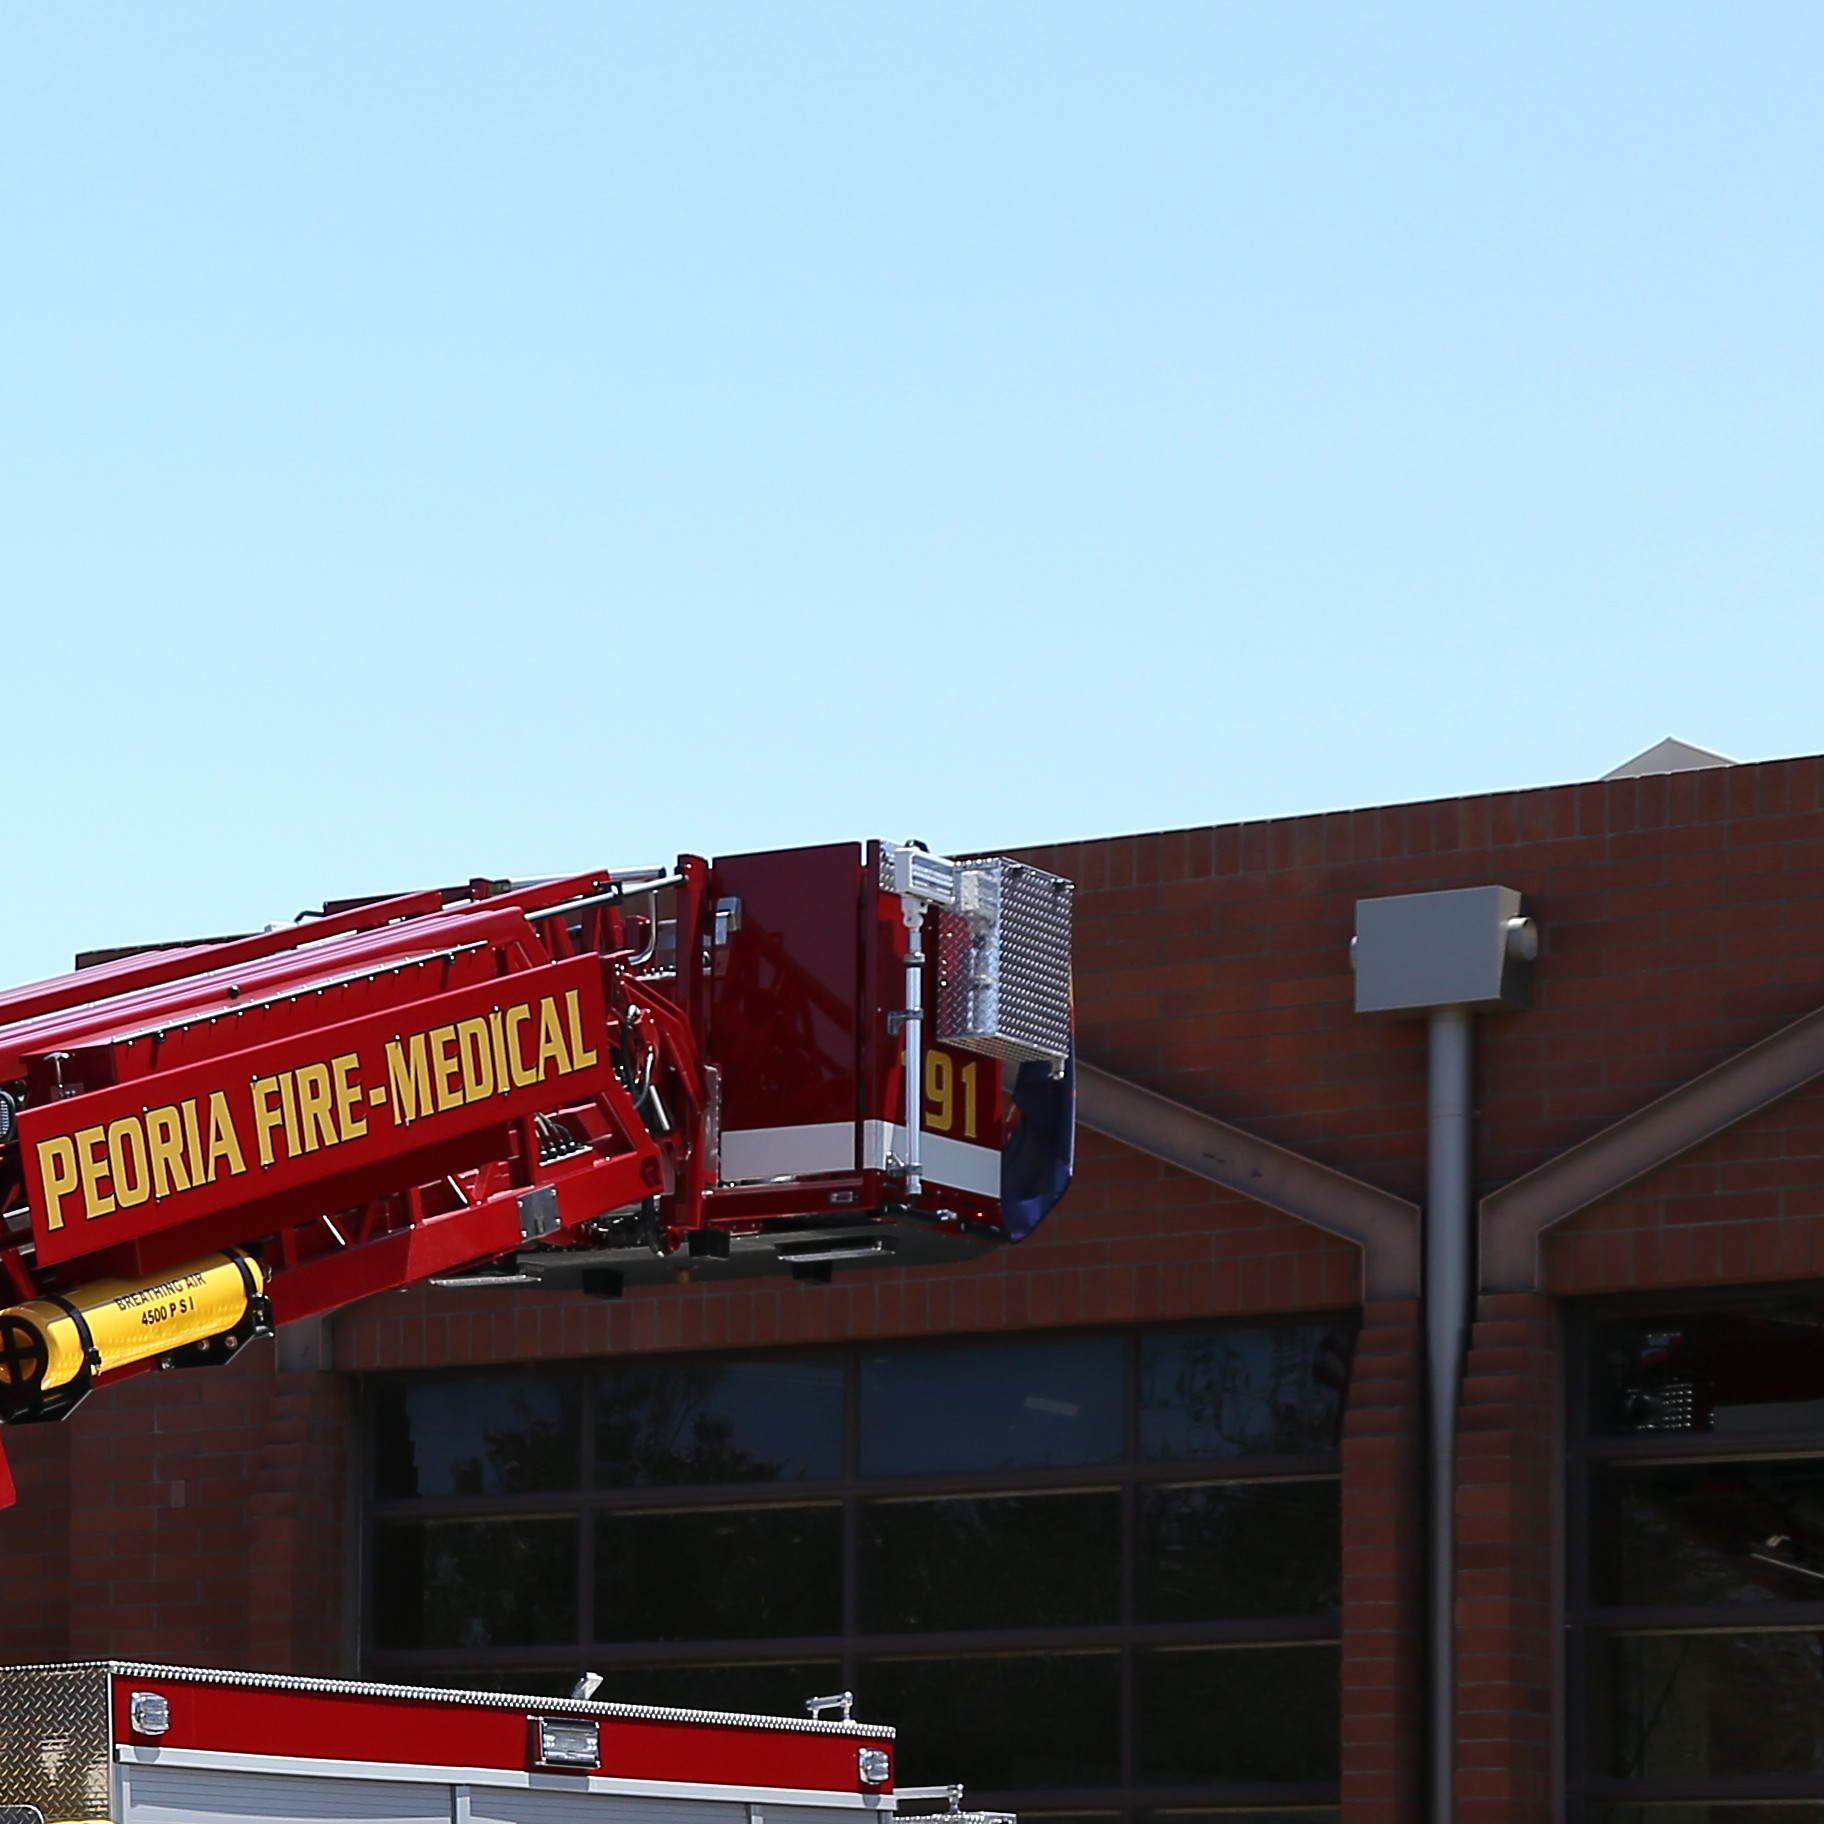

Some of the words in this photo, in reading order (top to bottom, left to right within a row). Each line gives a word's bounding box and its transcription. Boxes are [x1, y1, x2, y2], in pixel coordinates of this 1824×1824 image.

[36, 1090, 247, 1231] PEORIA
[249, 988, 599, 1168] FIRE-MEDICAL
[900, 1049, 977, 1138] 91
[115, 1279, 184, 1312] BREATHING
[185, 1272, 207, 1290] AIR
[141, 1307, 168, 1326] 4500
